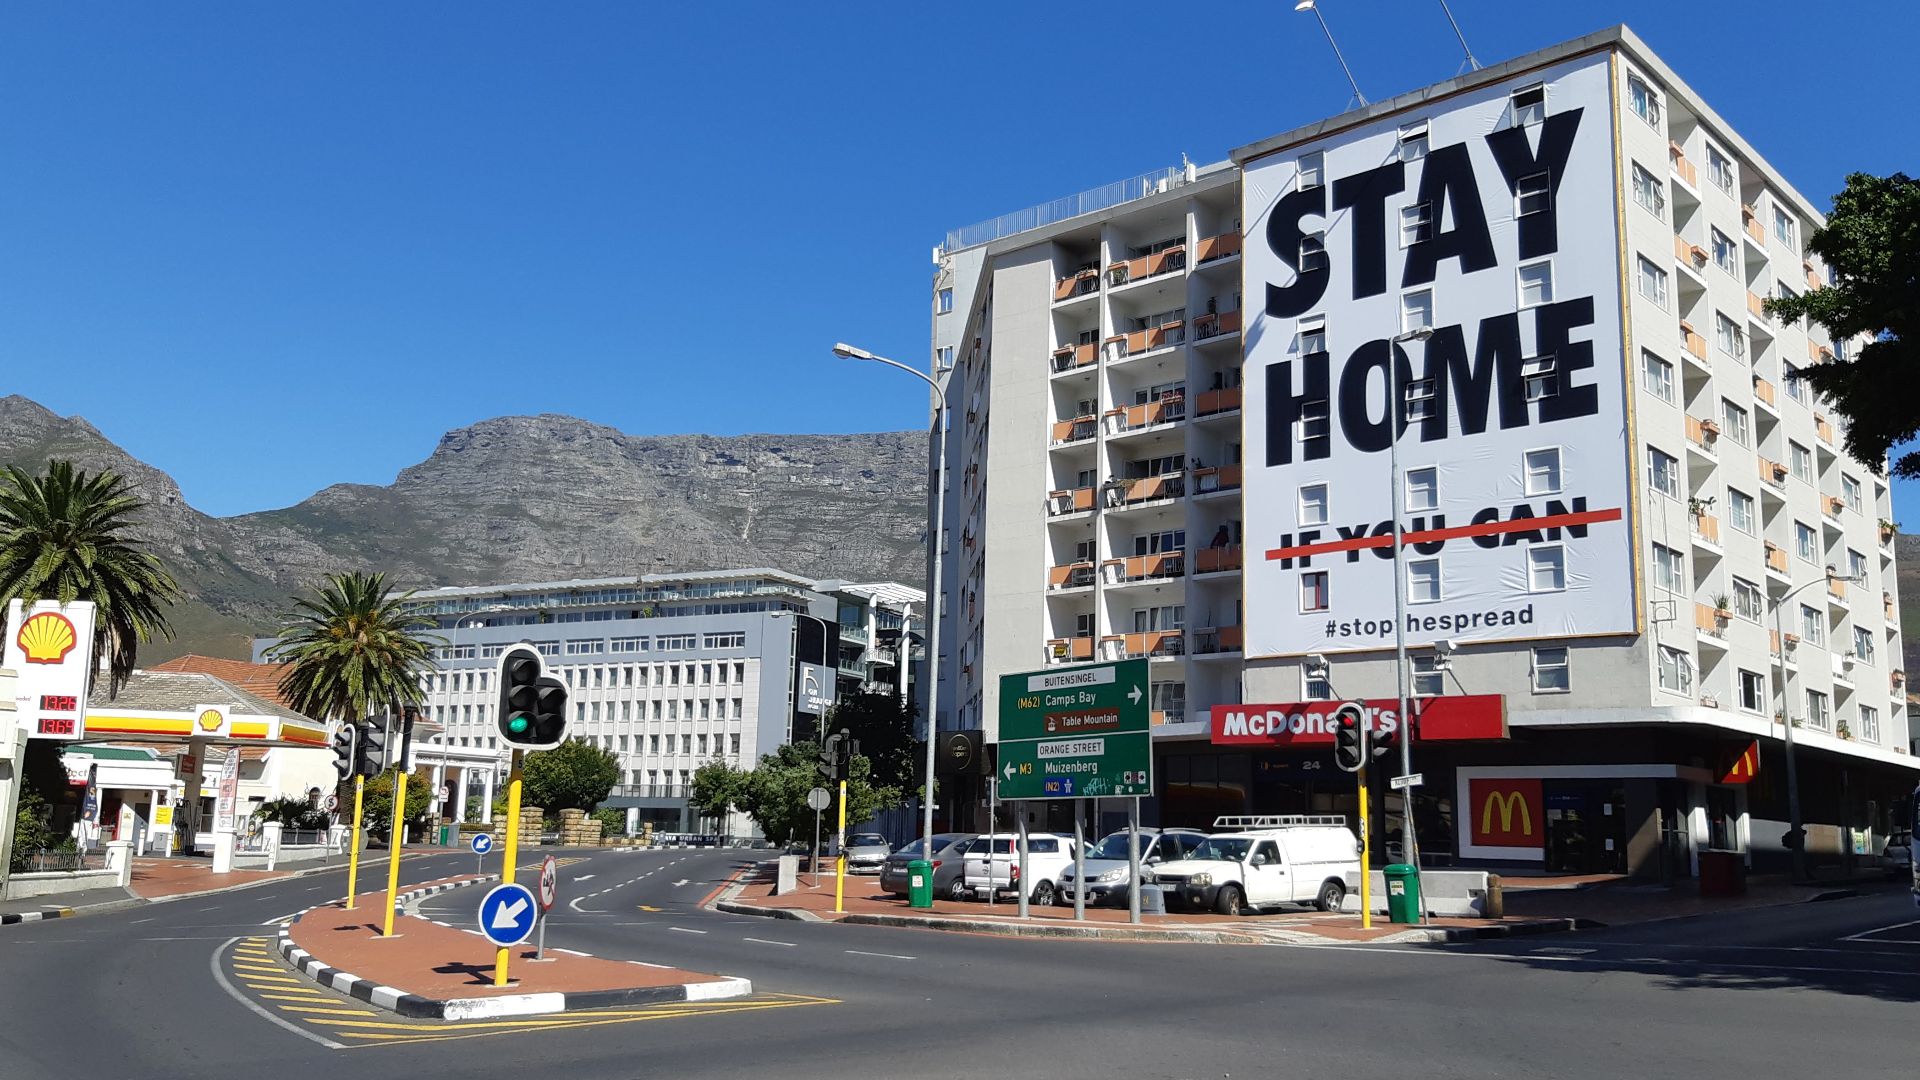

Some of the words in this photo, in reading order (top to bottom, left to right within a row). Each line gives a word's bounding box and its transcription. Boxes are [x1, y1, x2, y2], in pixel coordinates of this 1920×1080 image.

[1265, 107, 1585, 319] STAY
[1265, 295, 1599, 468] HOME
[1280, 530, 1321, 570] IF
[1336, 514, 1446, 564] YOU
[1470, 496, 1589, 549] CAN
[1325, 603, 1534, 638] #stophespread
[1044, 673, 1097, 687] BUITENSINGEL
[1017, 696, 1040, 710] (M62)
[1045, 694, 1076, 708] Camps
[1079, 691, 1097, 705] Bay
[1062, 716, 1081, 727] Table
[1083, 713, 1118, 725] Mountain
[1039, 744, 1070, 755] ORANGE
[1073, 742, 1102, 753] STREET
[1019, 763, 1032, 774] M3
[1045, 761, 1098, 776] Muizenberg
[1302, 761, 1321, 770] 24
[1045, 782, 1060, 792] (N2)
